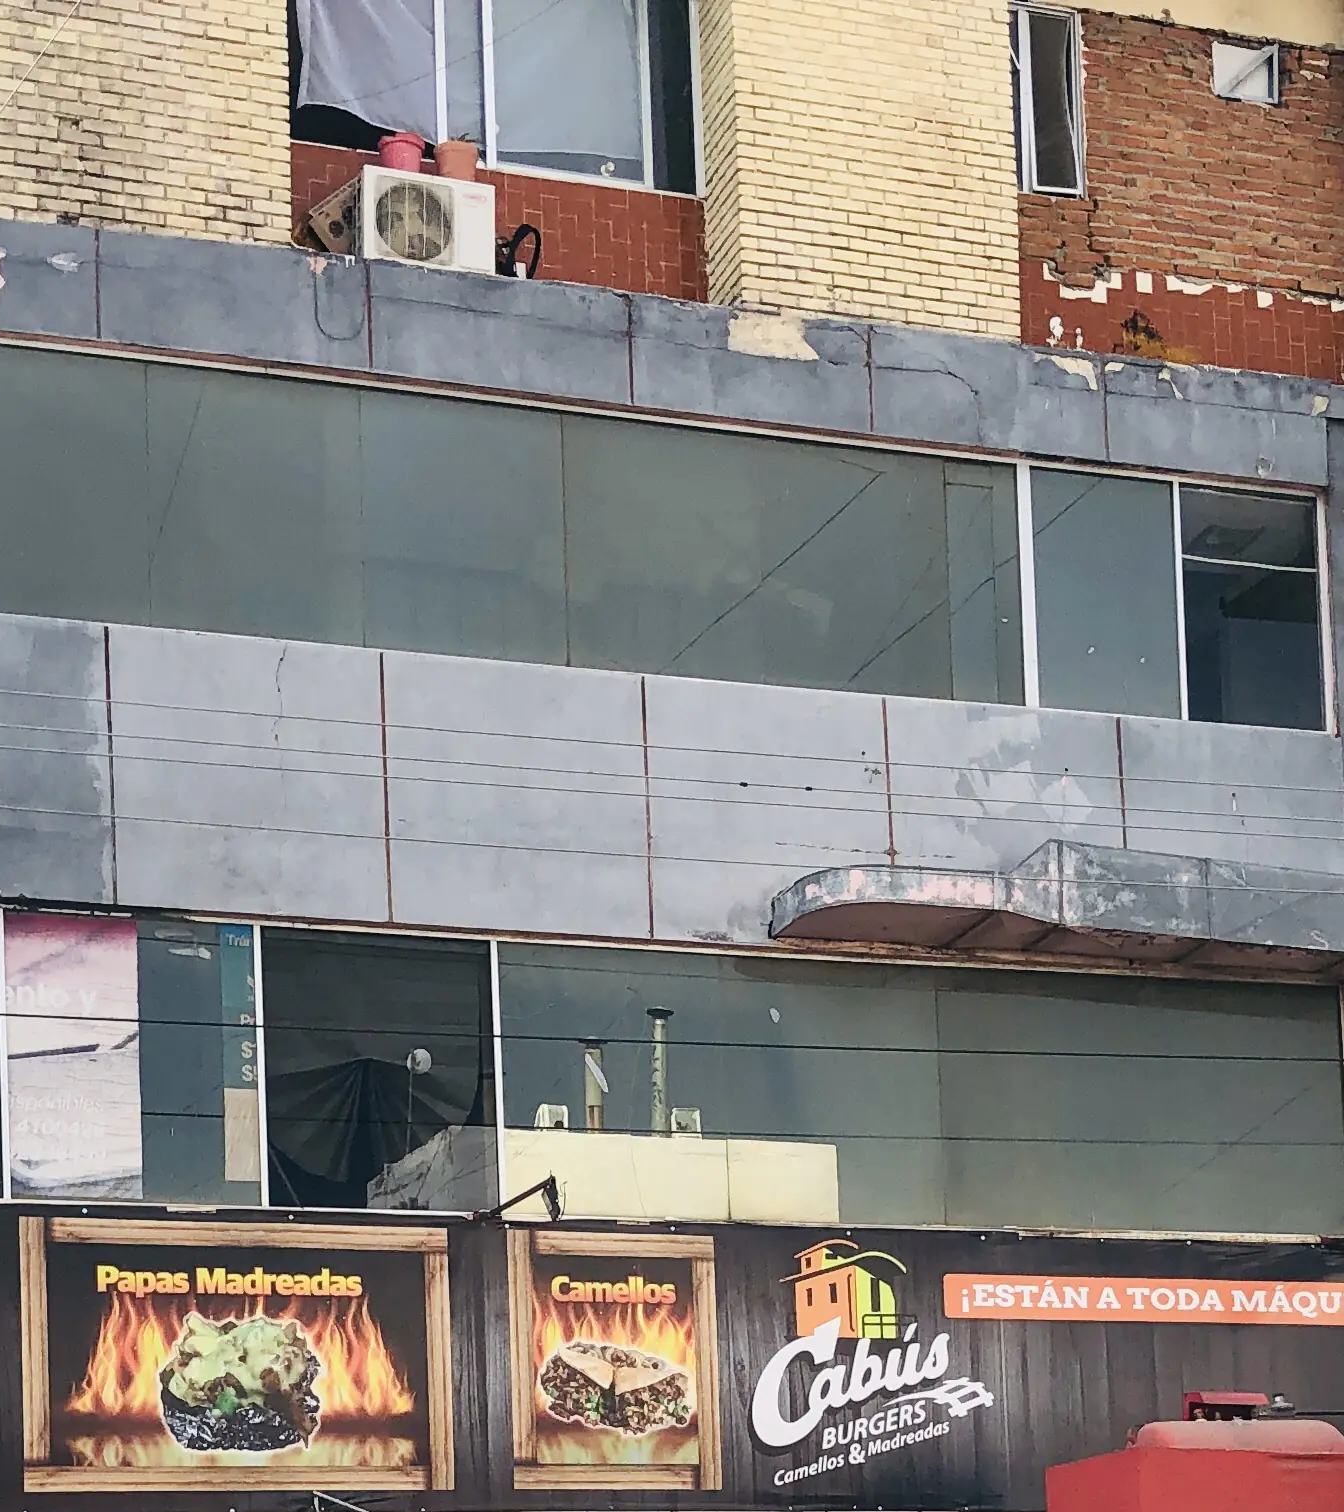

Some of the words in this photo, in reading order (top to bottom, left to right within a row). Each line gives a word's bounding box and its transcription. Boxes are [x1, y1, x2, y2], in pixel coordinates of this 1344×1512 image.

[96, 1265, 189, 1298] Papas
[195, 1267, 364, 1299] Madreadas
[551, 1275, 677, 1305] Camellos
[960, 1280, 1090, 1312] ¡ESTÁN
[1096, 1286, 1122, 1310] A
[1126, 1286, 1225, 1312] TODA
[752, 1316, 950, 1448] Cabús
[822, 1400, 926, 1450] BURGERS
[773, 1453, 845, 1486] Camellos
[848, 1443, 866, 1465] &
[867, 1420, 950, 1457] Madreadas
